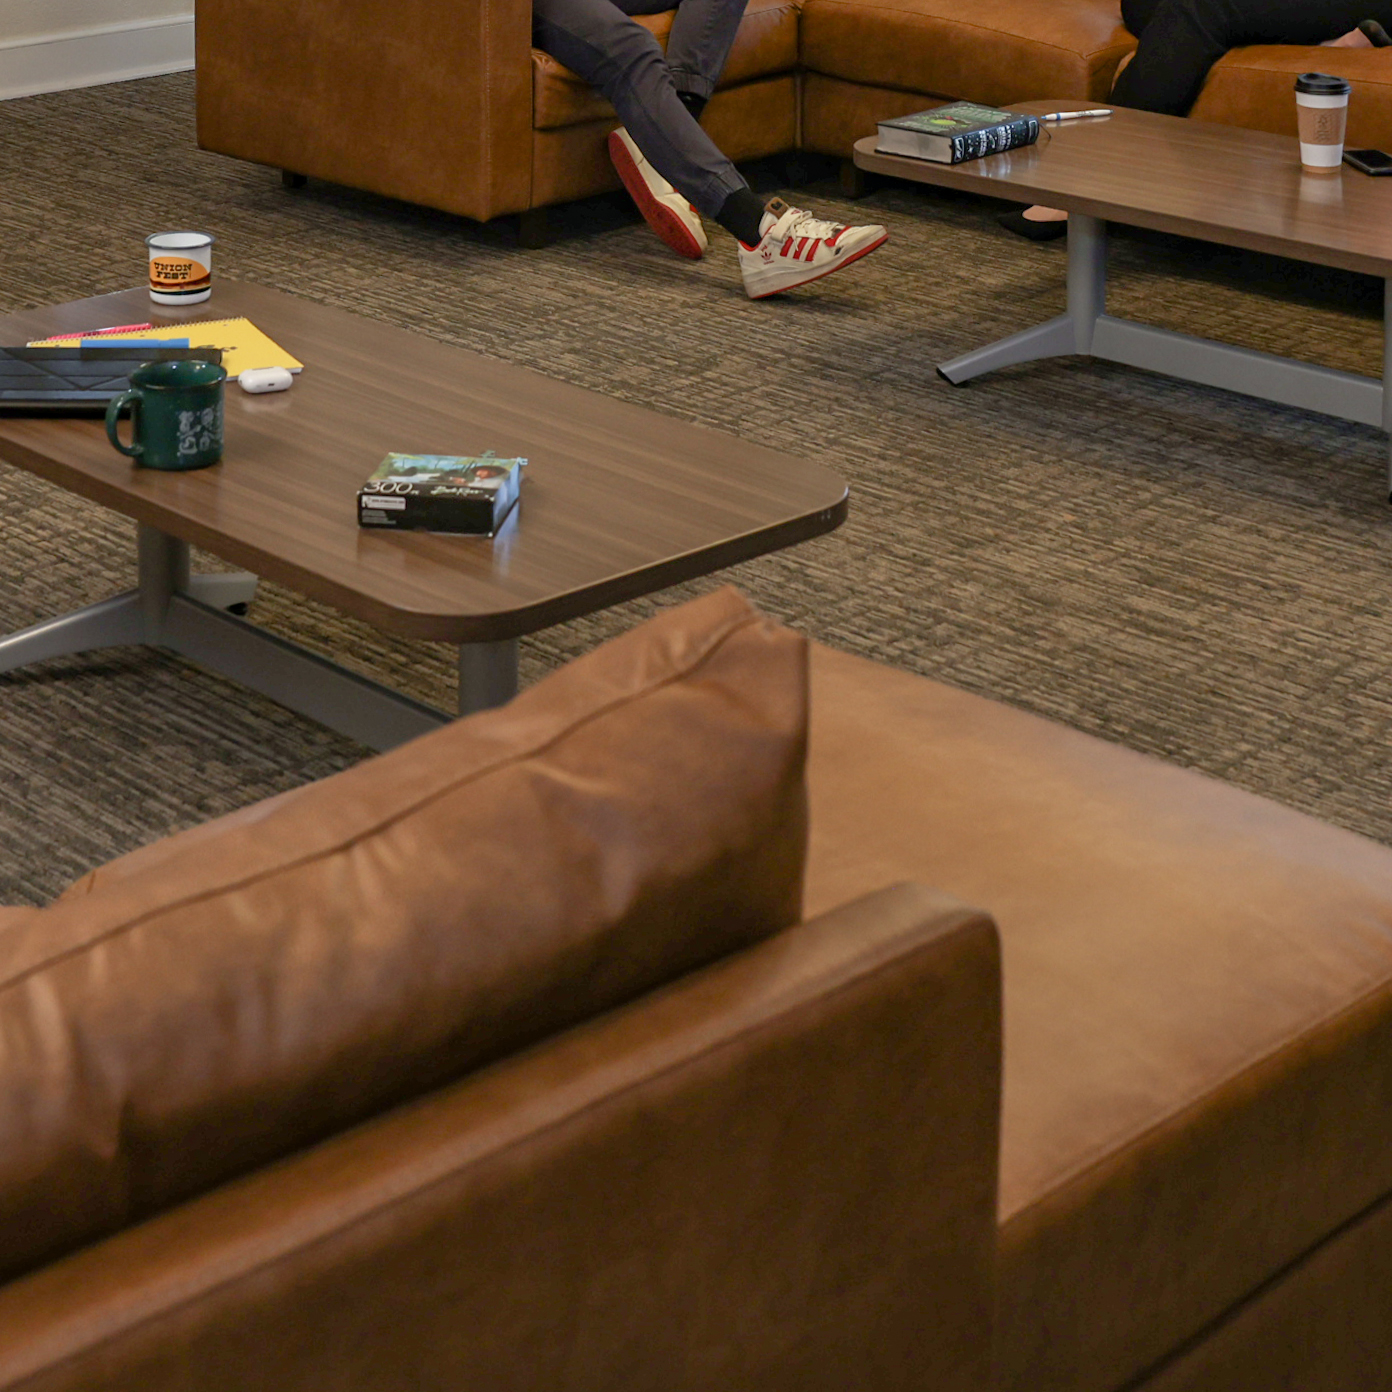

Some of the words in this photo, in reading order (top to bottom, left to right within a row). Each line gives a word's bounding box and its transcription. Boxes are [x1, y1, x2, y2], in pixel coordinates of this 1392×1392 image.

[154, 262, 193, 271] UNION
[156, 271, 188, 279] FEST
[363, 481, 413, 495] 300
